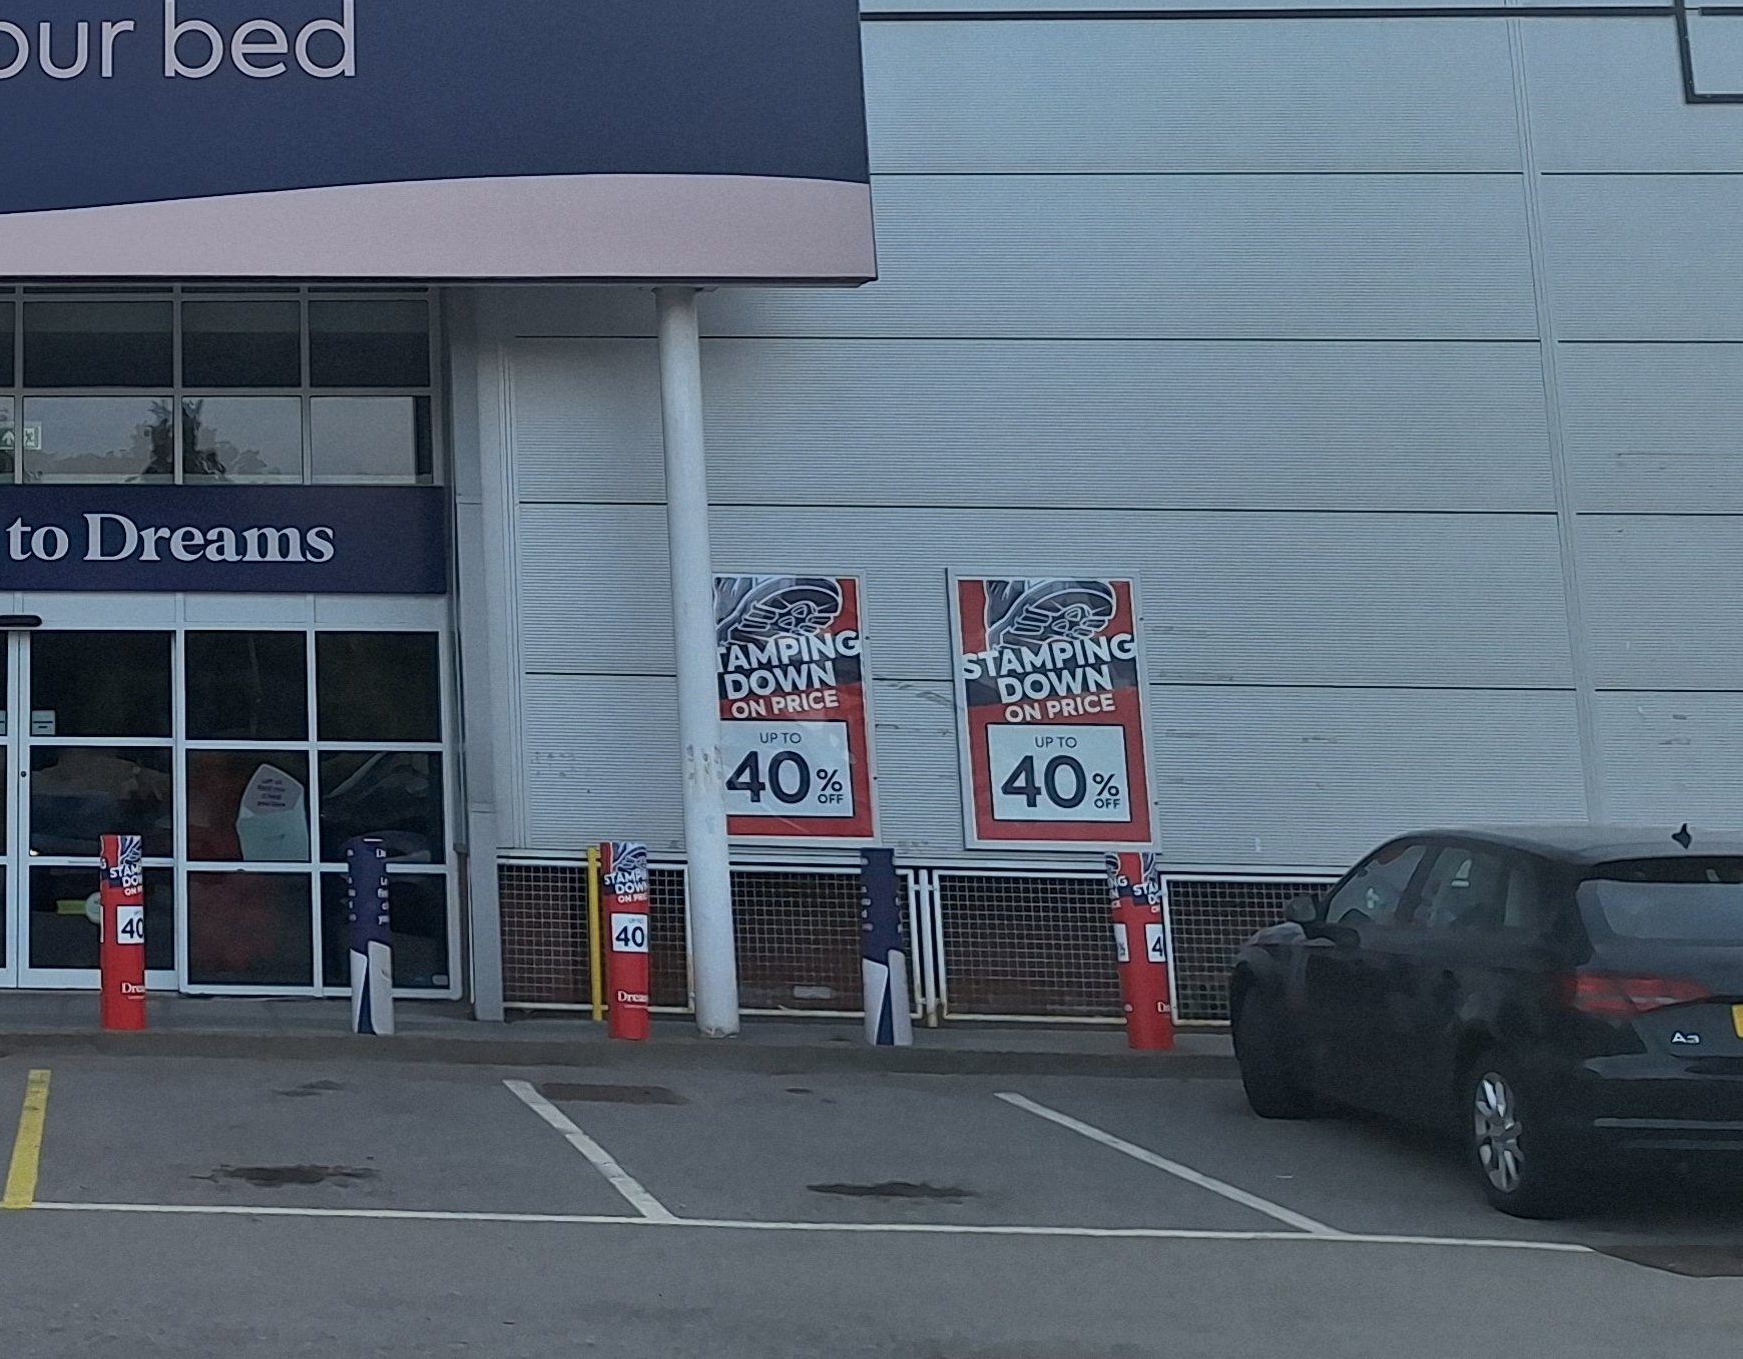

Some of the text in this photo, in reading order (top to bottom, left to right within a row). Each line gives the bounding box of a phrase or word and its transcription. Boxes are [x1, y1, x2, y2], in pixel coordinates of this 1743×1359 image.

[6, 516, 69, 561] to
[83, 513, 335, 563] Dreams
[717, 630, 862, 673] TAMPING
[961, 633, 1137, 680] STAMPING
[724, 660, 837, 700] DOWN
[997, 665, 1113, 704] DOWN
[731, 689, 839, 719] ON PRICE
[1005, 694, 1116, 723] ON PRICE
[759, 732, 802, 744] UP TO
[1034, 736, 1078, 748] UP TO
[817, 794, 845, 805] OFF
[1093, 798, 1121, 809] OFF
[617, 895, 632, 903] ON
[615, 926, 645, 947] 40
[1671, 1032, 1700, 1044] A3
